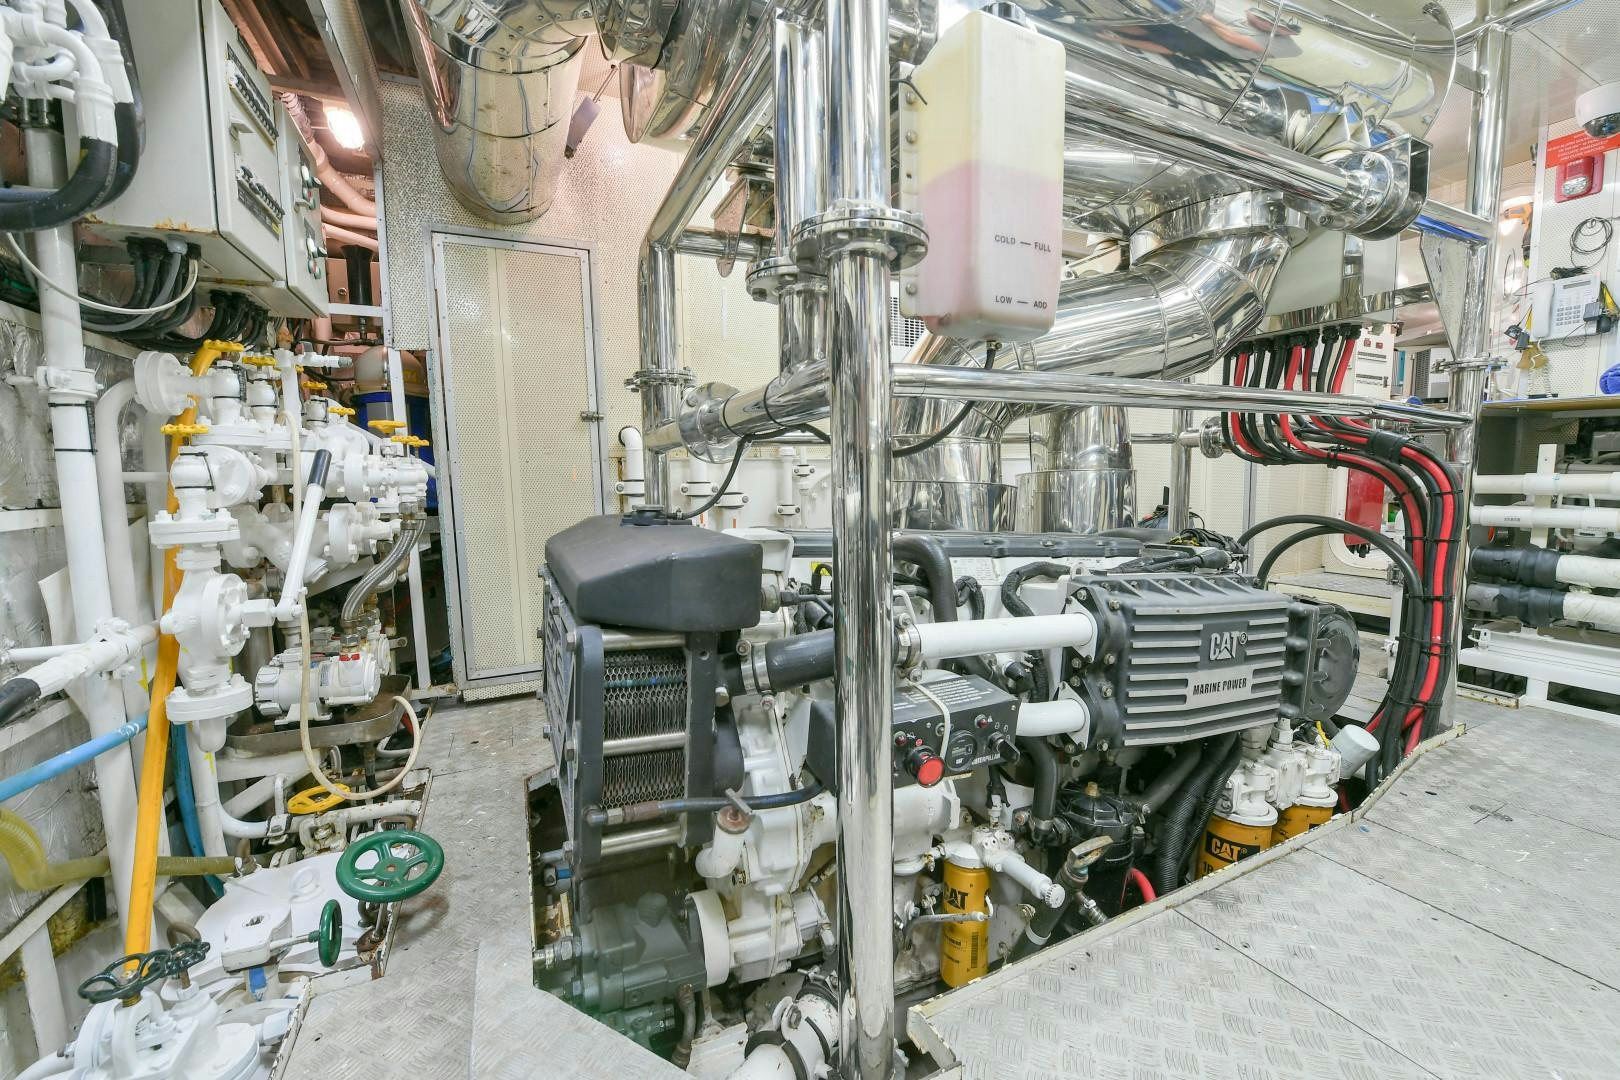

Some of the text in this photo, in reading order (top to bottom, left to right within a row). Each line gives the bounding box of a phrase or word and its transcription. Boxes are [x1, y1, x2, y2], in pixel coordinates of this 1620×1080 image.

[994, 234, 1052, 253] COLD FULL
[995, 295, 1048, 310] LOW ADD
[1193, 677, 1247, 696] MARINE POWER
[944, 882, 968, 910] CAT
